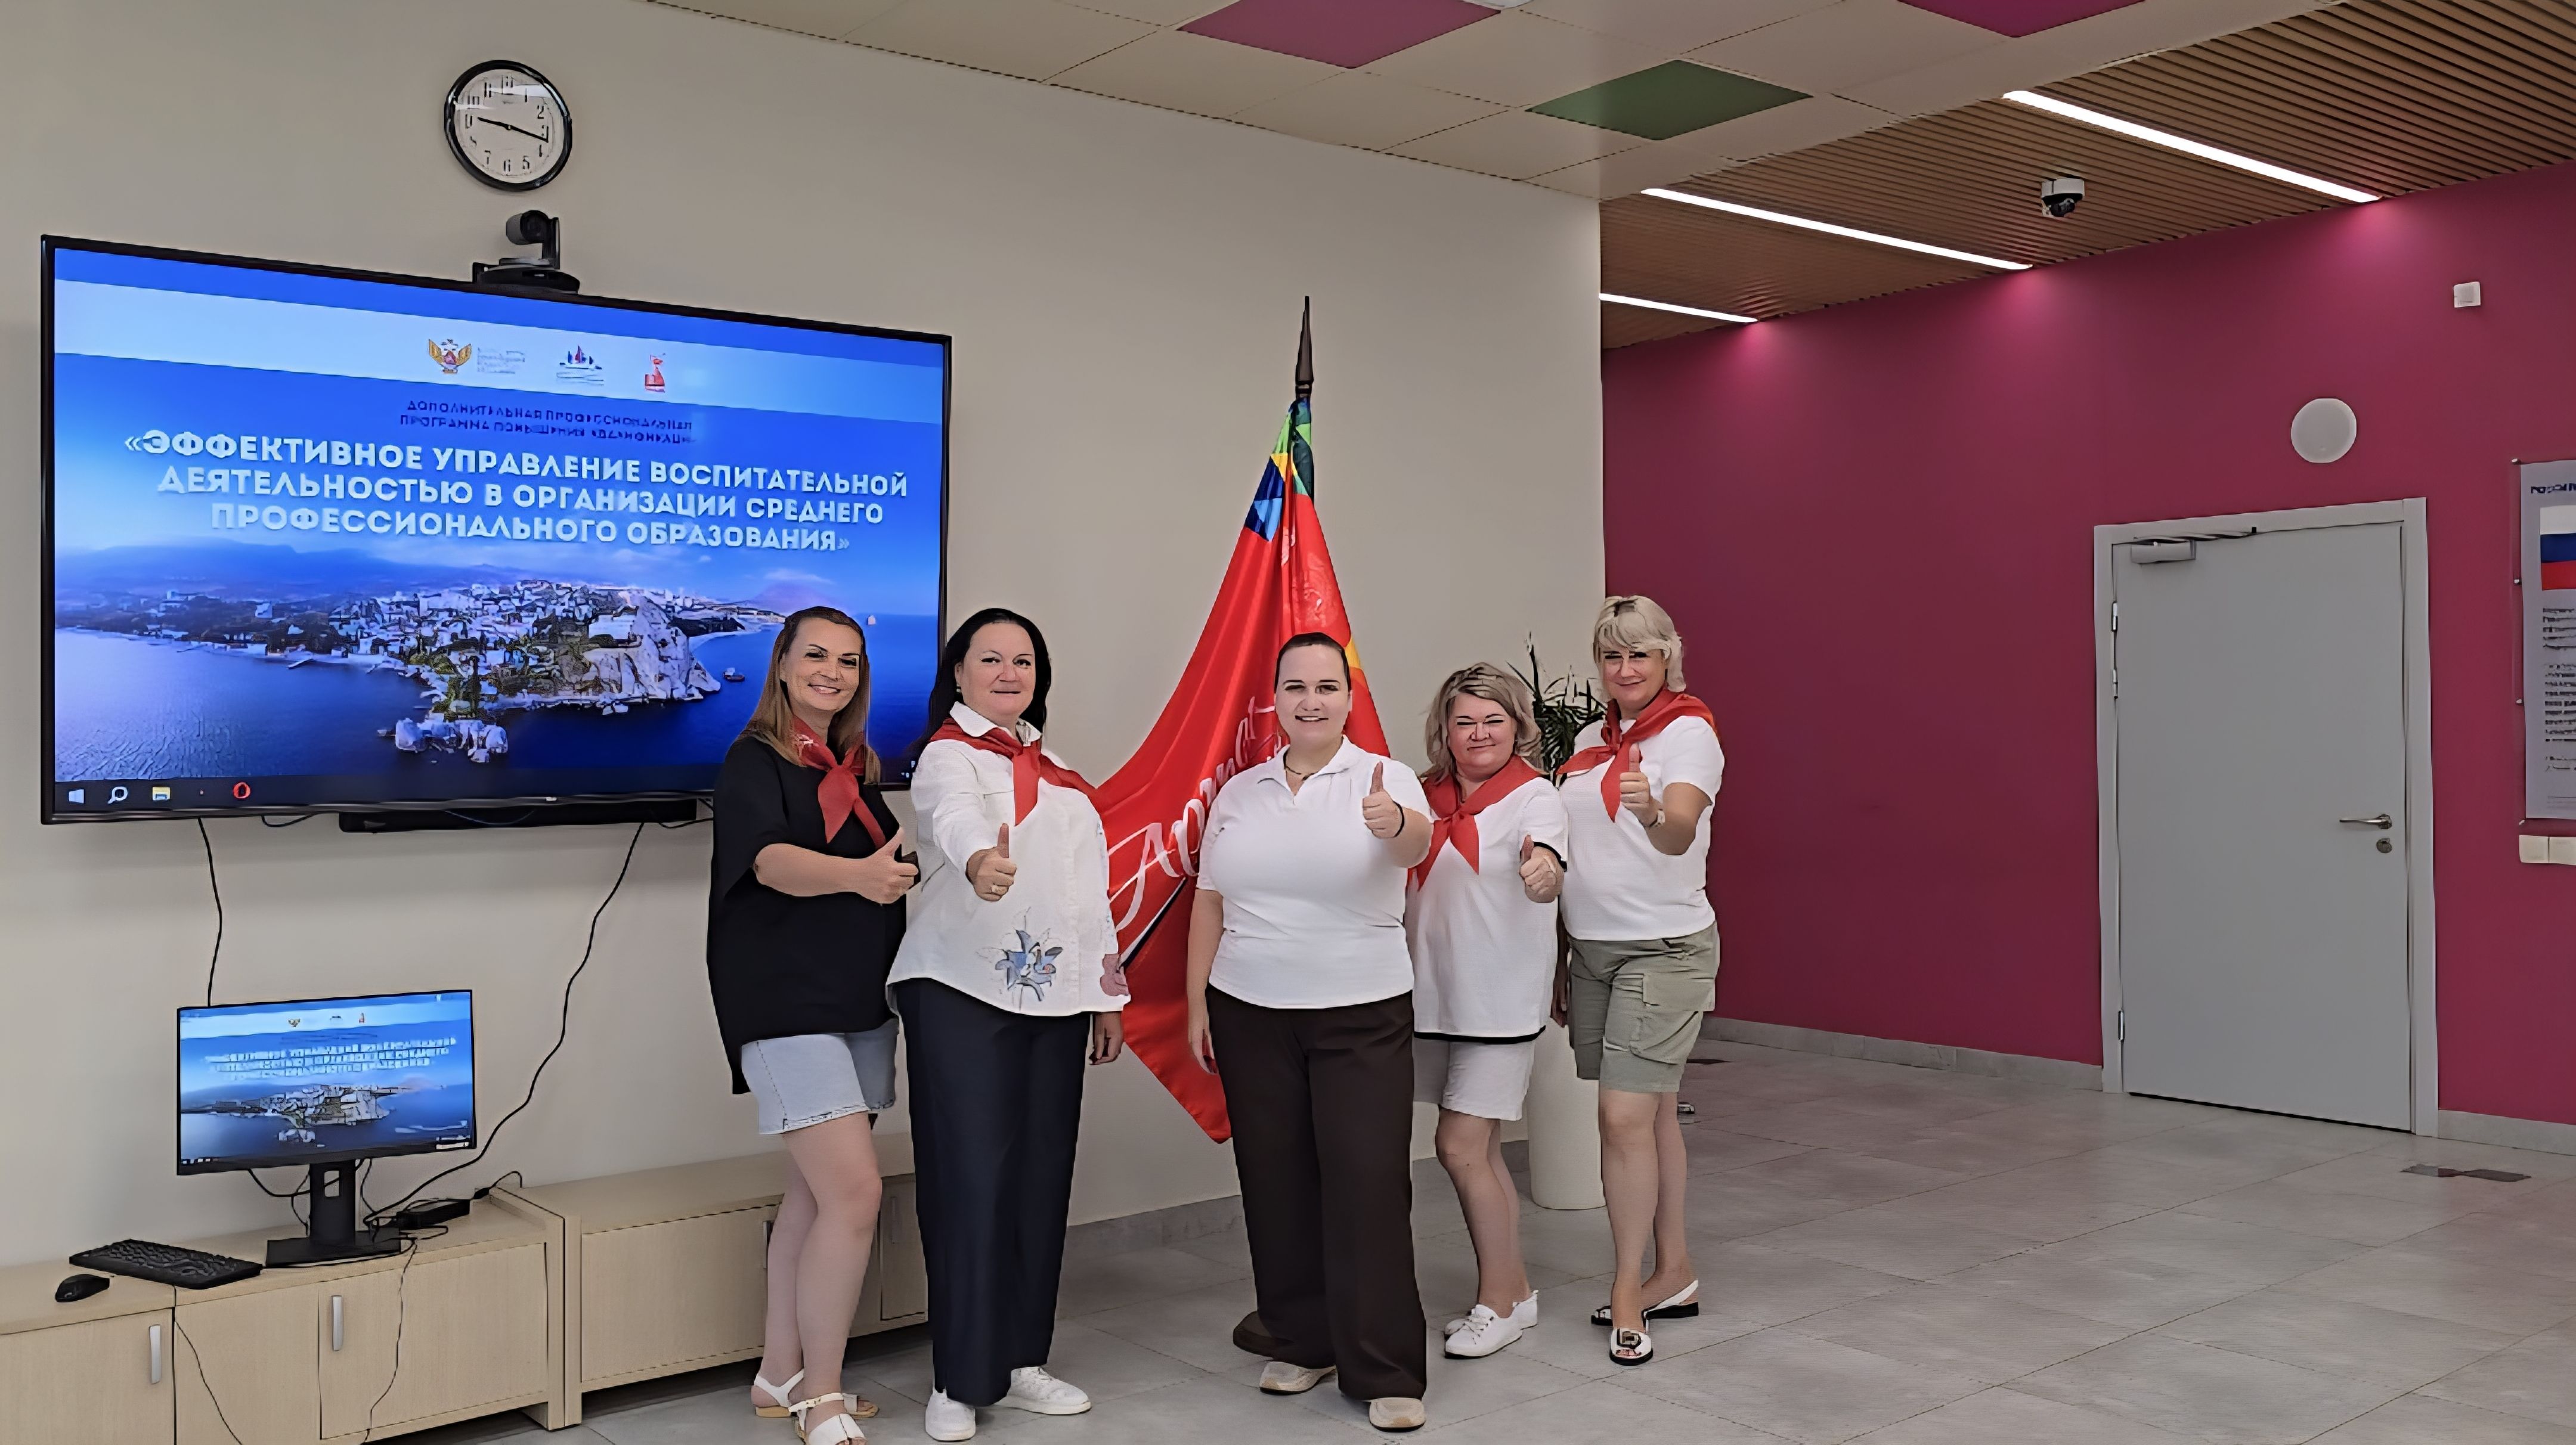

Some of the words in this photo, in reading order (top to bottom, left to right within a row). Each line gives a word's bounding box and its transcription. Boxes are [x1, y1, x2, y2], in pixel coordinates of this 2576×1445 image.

[125, 429, 423, 470] «ЭФФЕКТИВНОЕ
[432, 447, 640, 482] УПРАВЛЕНИЕ
[650, 461, 907, 497] ВОСПИТАТЕЛЬНОЙ
[157, 466, 473, 504] ДЕЯТЕЛЬНОСТЬЮ
[484, 483, 502, 507] В
[513, 484, 735, 519] ОРГАНИЗАЦИИ
[746, 498, 883, 523] СРЕДНЕГО
[211, 503, 617, 543] ПРОФЕССИОНАЛЬНОГО
[627, 521, 850, 551] ОБРАЗОВАНИЯ»
